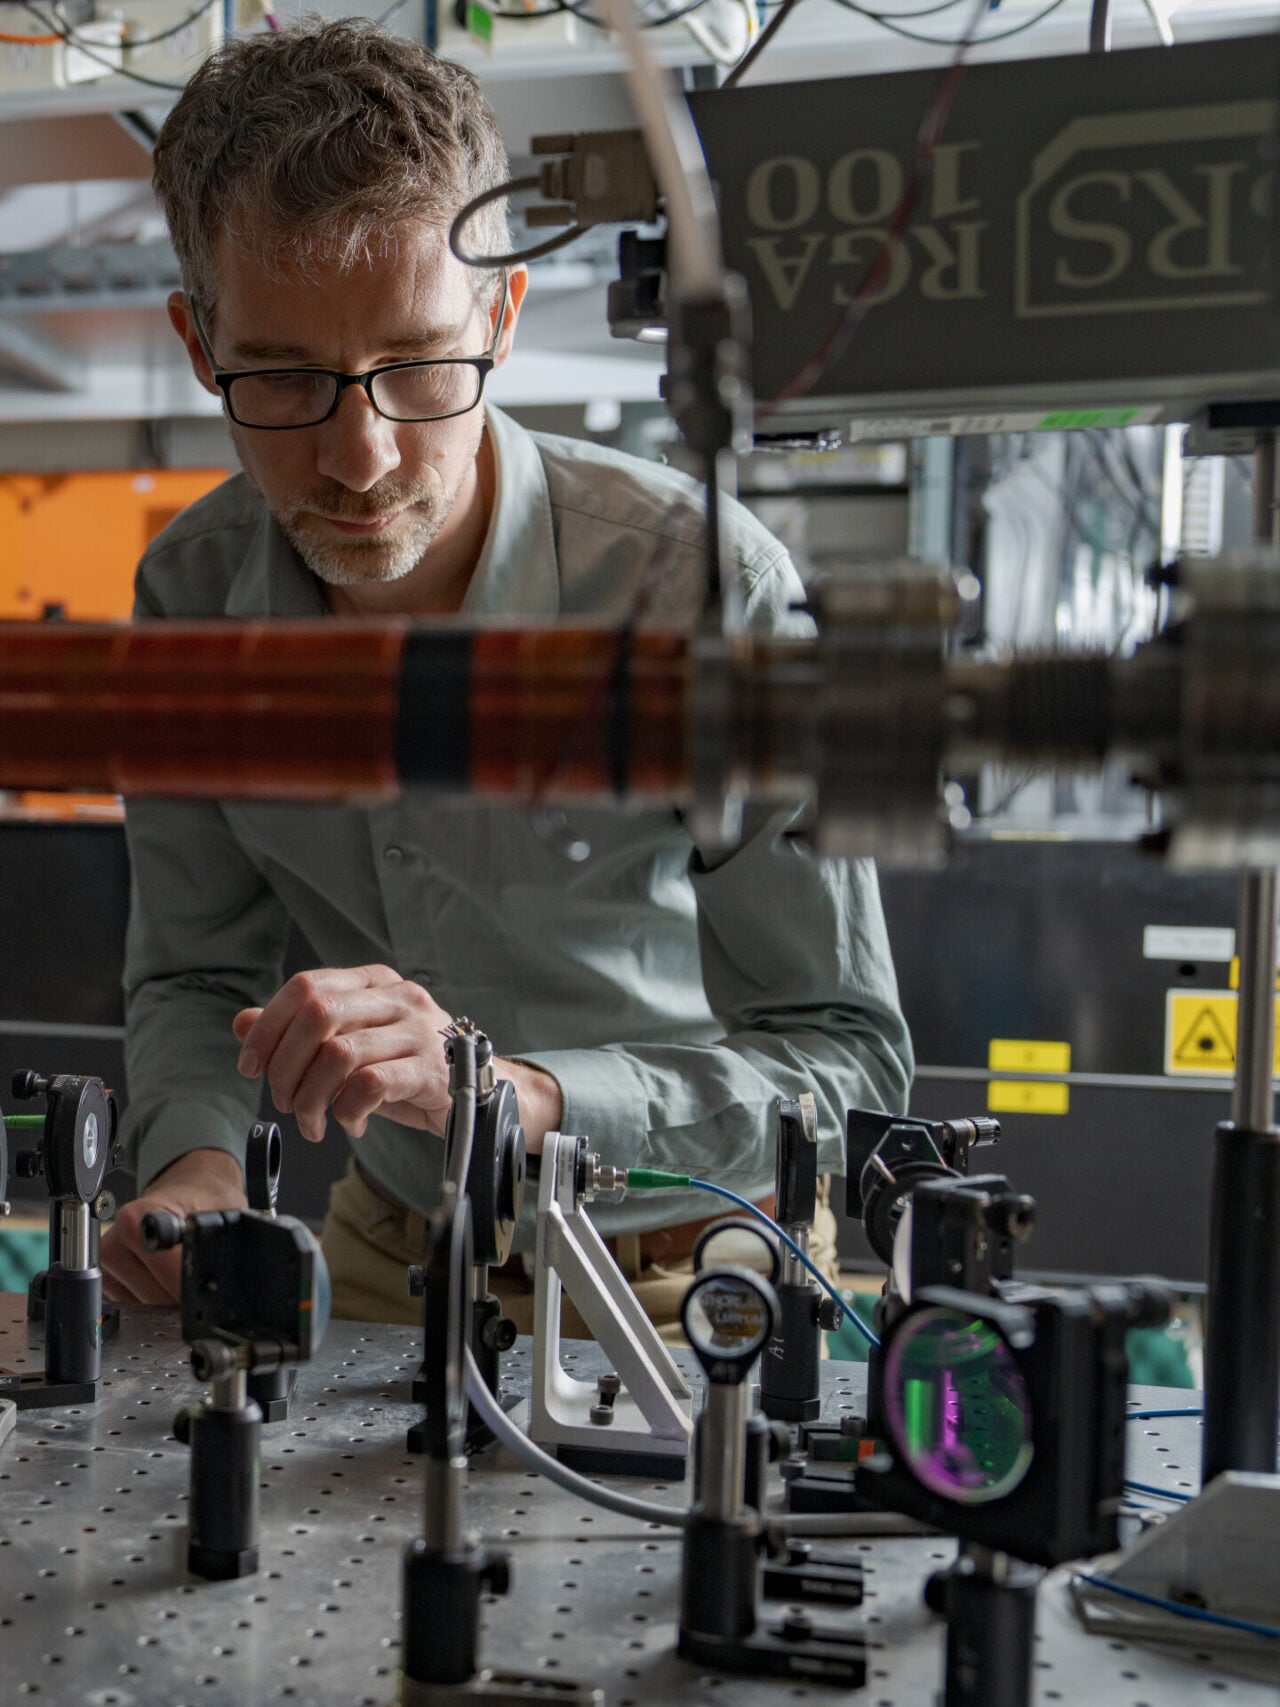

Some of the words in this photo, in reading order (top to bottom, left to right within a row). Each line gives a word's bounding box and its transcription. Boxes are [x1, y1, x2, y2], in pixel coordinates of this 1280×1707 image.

[747, 142, 980, 230] 100
[1048, 160, 1274, 288] RS
[749, 222, 987, 310] RGA
